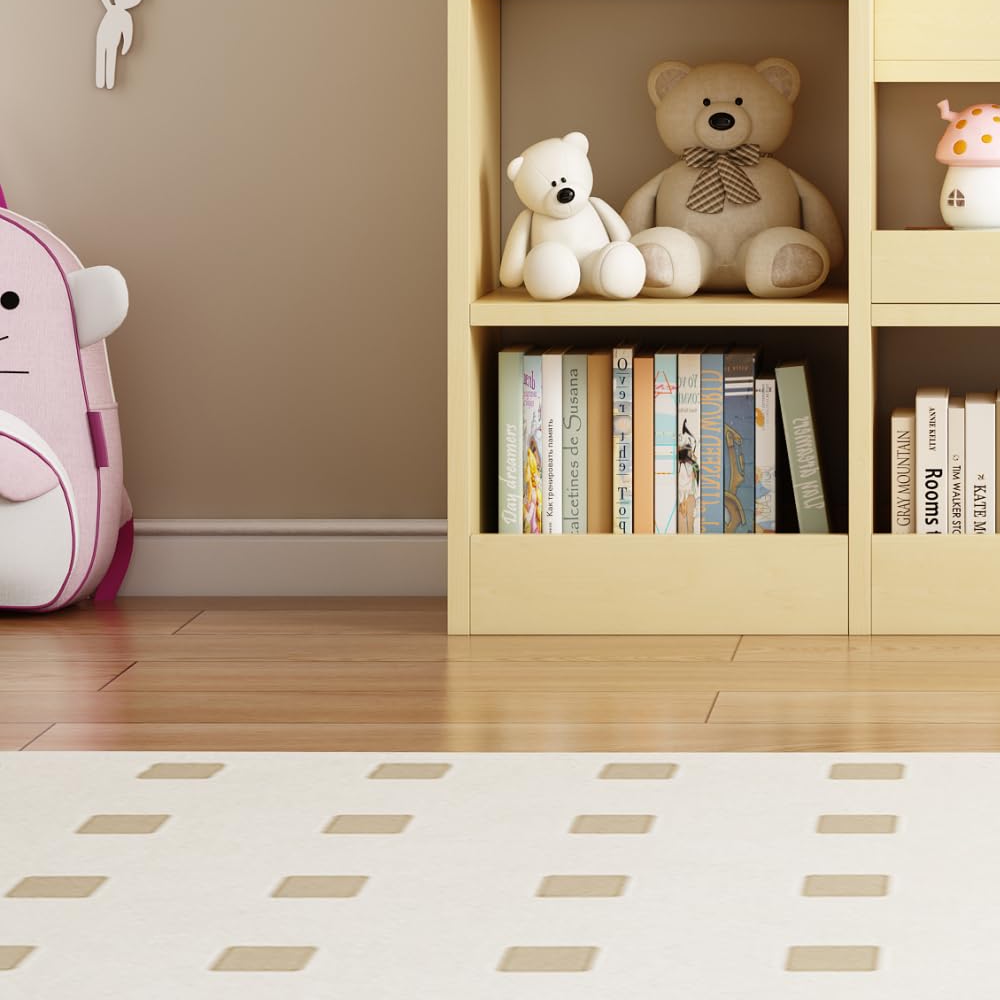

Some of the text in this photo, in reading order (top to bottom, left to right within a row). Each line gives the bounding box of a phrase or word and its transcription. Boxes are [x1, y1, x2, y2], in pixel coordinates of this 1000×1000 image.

[546, 418, 555, 448] память
[562, 368, 582, 534] alcetines de Susana
[499, 423, 521, 525] Day dreamers
[547, 449, 556, 501] тренировать
[897, 430, 910, 527] GRAY MOUNTAIN
[925, 468, 943, 526] Rooms
[952, 465, 961, 480] TIM
[546, 502, 555, 517] Как
[952, 482, 961, 518] WALKER
[973, 485, 987, 534] KATE M
